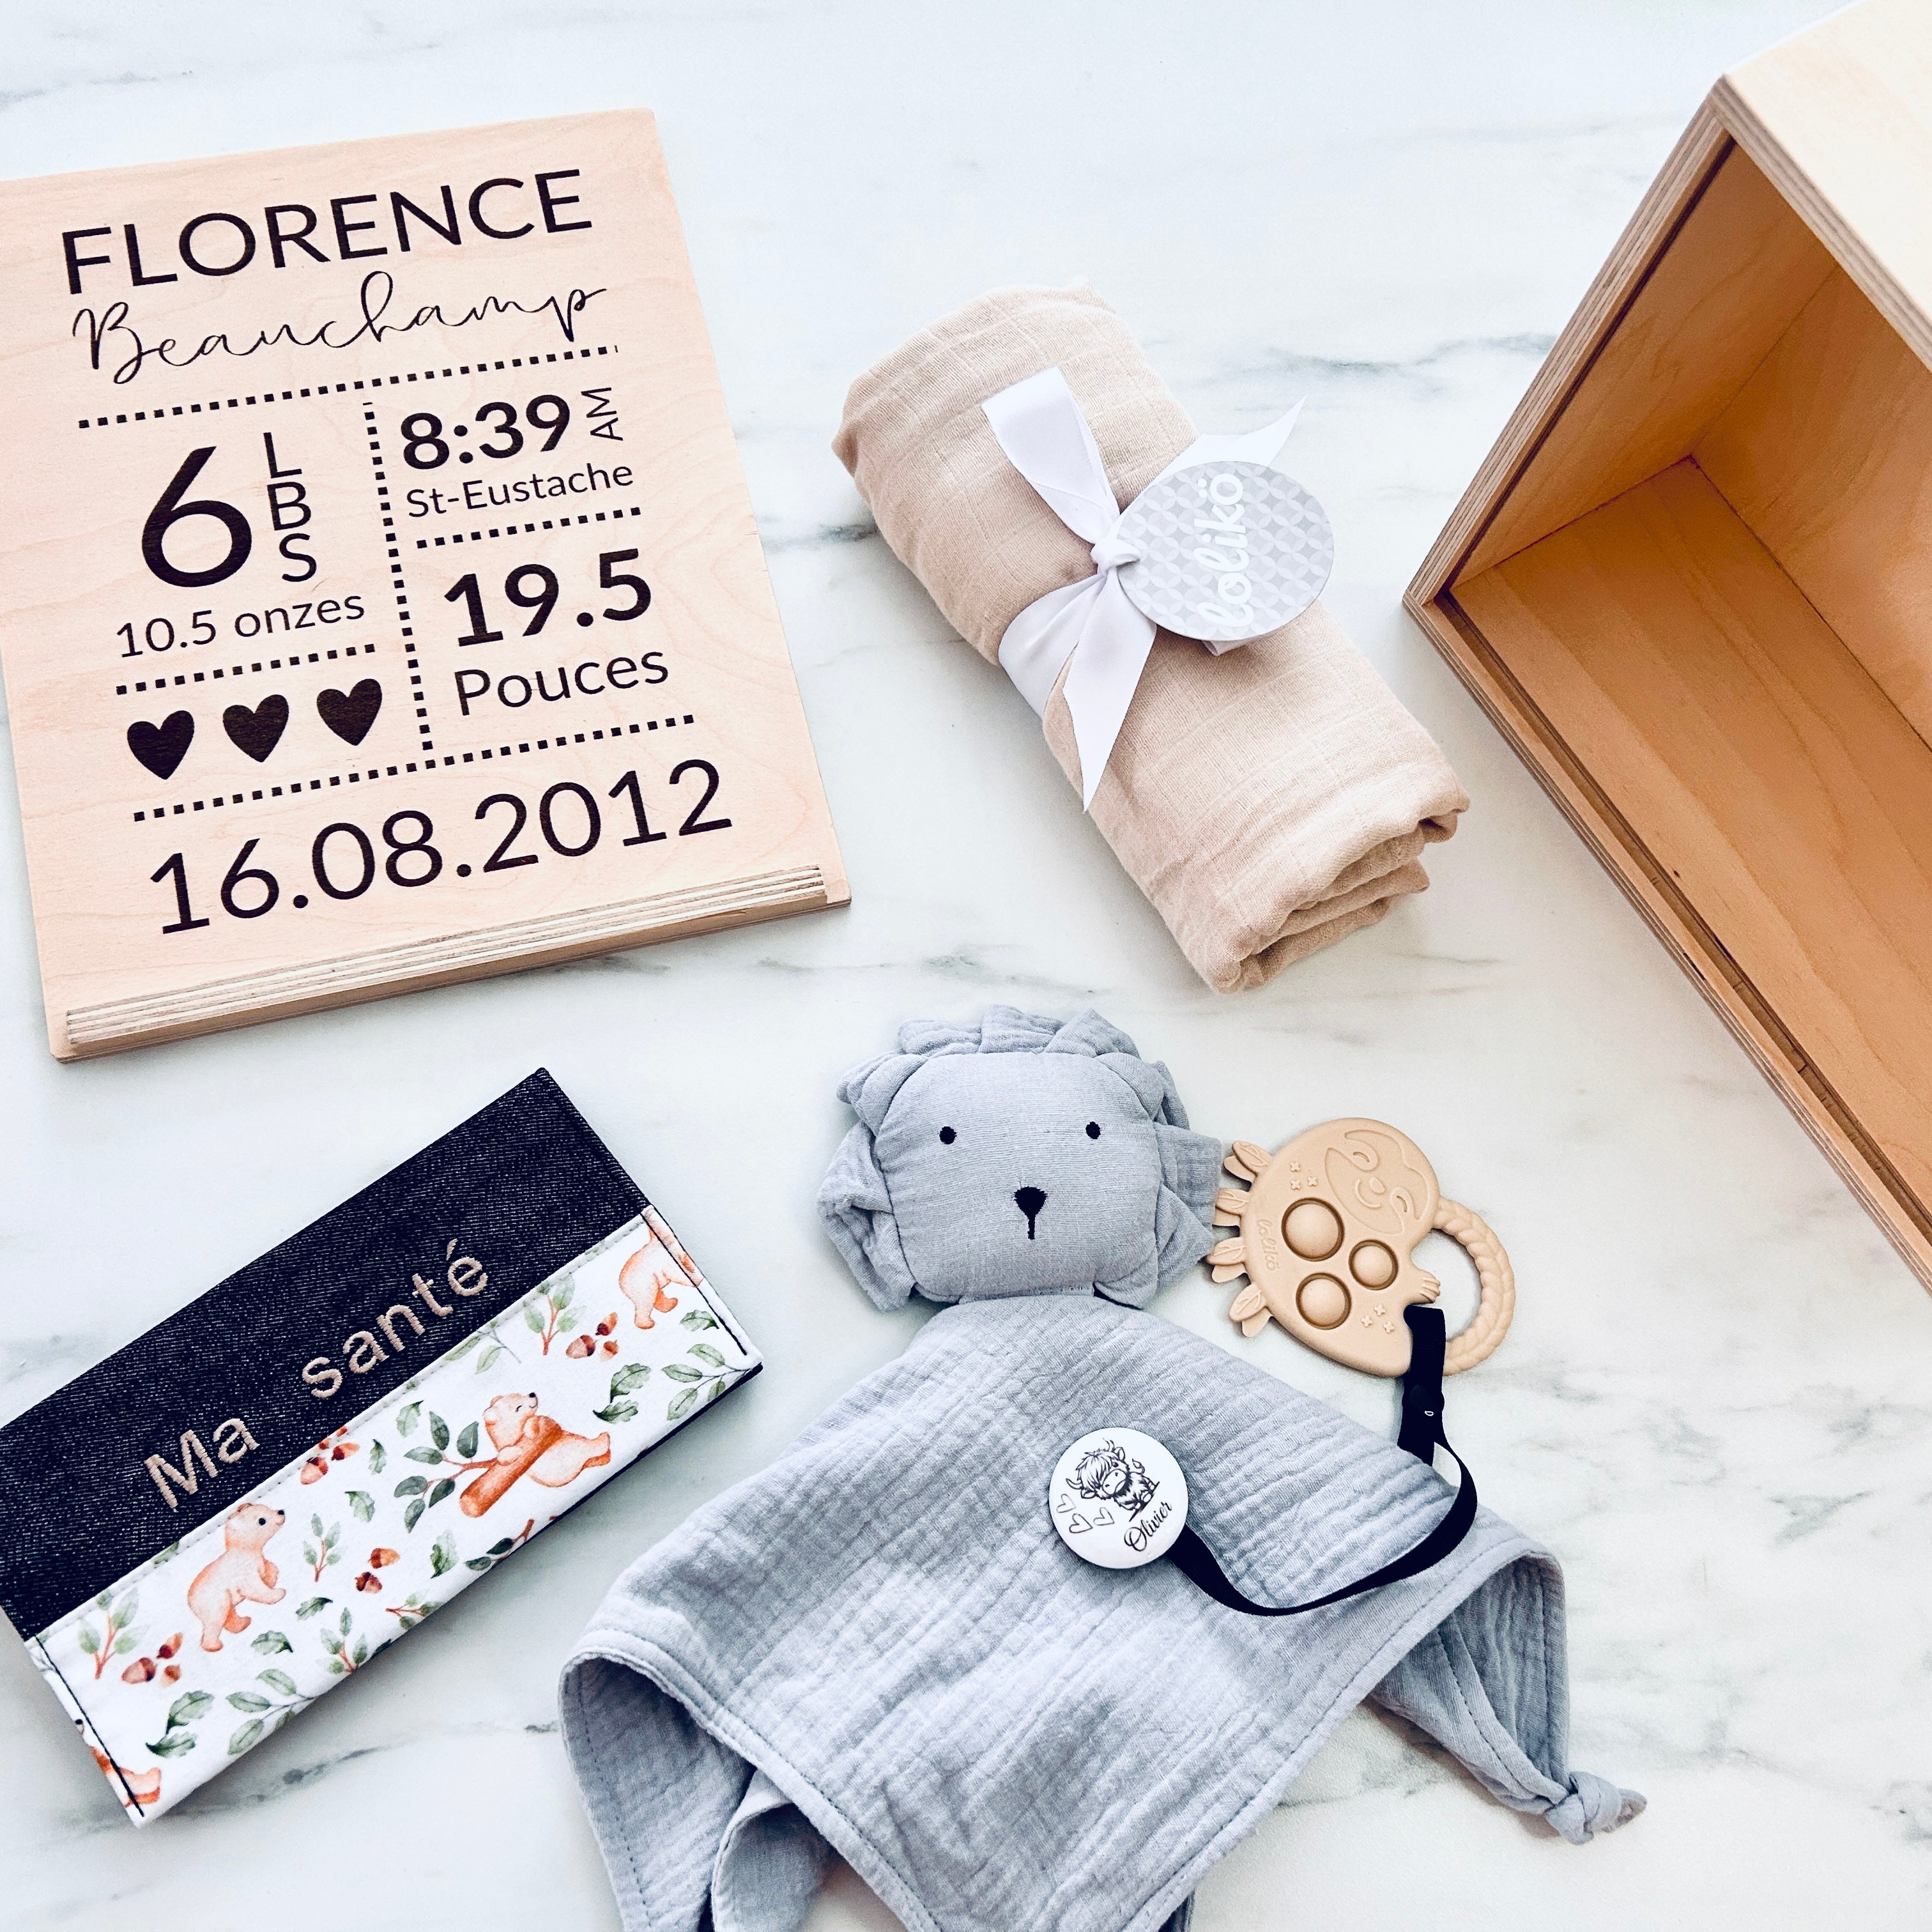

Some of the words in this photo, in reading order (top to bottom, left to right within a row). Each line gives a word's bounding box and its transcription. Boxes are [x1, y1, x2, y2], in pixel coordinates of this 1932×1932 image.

[62, 169, 592, 295] FLORENCE
[72, 270, 608, 385] Beauchamp
[401, 394, 571, 470] 8:39
[581, 387, 624, 441] AM
[142, 446, 252, 587] 6
[406, 462, 633, 518] St-Eustache
[116, 610, 217, 659] 10.5
[234, 590, 365, 638] onzes
[443, 548, 652, 647] 19.5
[454, 651, 668, 716] Pouces
[150, 759, 733, 935] 16.08.2012
[144, 1416, 259, 1512] Ma
[301, 1238, 488, 1400] santé
[1124, 1501, 1172, 1551] Olivier
